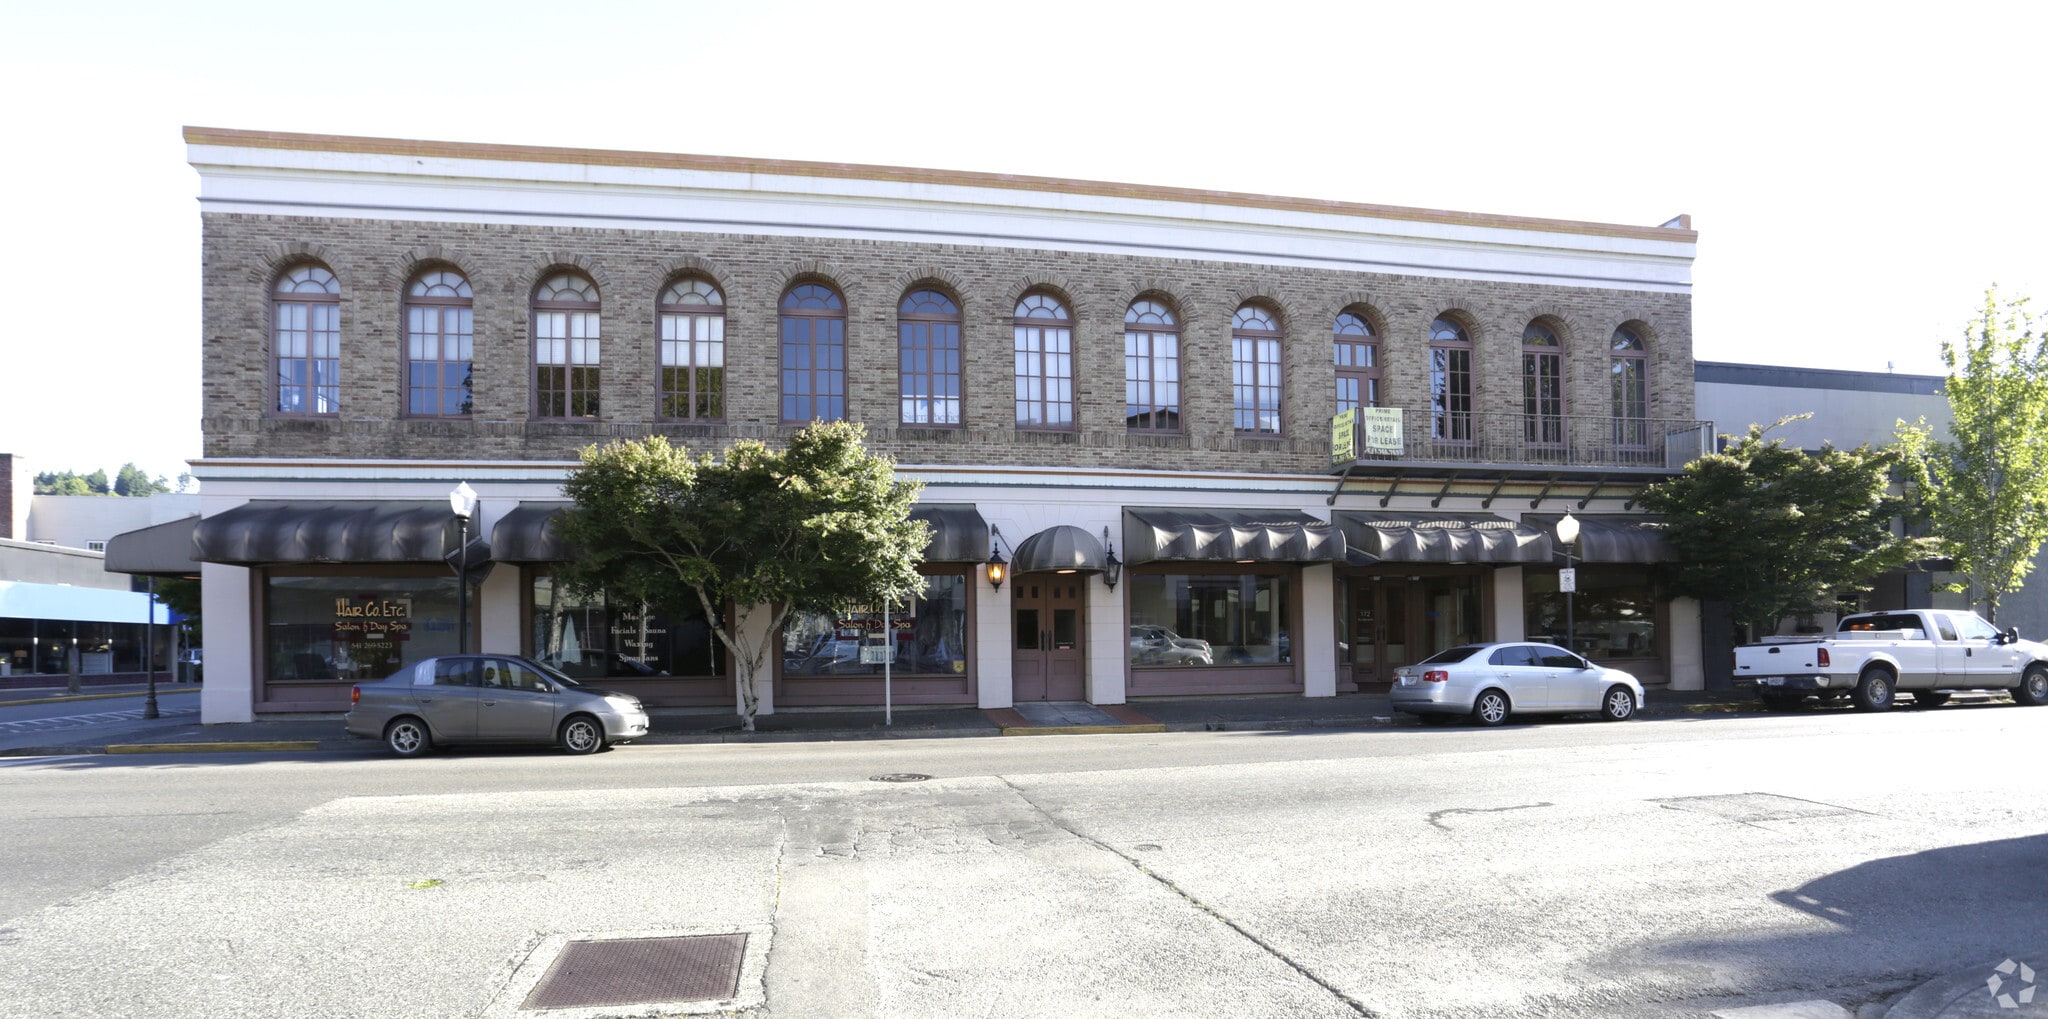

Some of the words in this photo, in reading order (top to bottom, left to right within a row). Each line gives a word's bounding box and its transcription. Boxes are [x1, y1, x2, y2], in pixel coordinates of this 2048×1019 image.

[1372, 424, 1394, 434] SPACE
[1380, 437, 1401, 446] LEASE
[335, 621, 360, 631] Salon
[369, 621, 388, 633] Day
[390, 620, 408, 633] Spa
[838, 619, 864, 630] Salon
[894, 619, 912, 630] Spa
[611, 626, 636, 634] Facials
